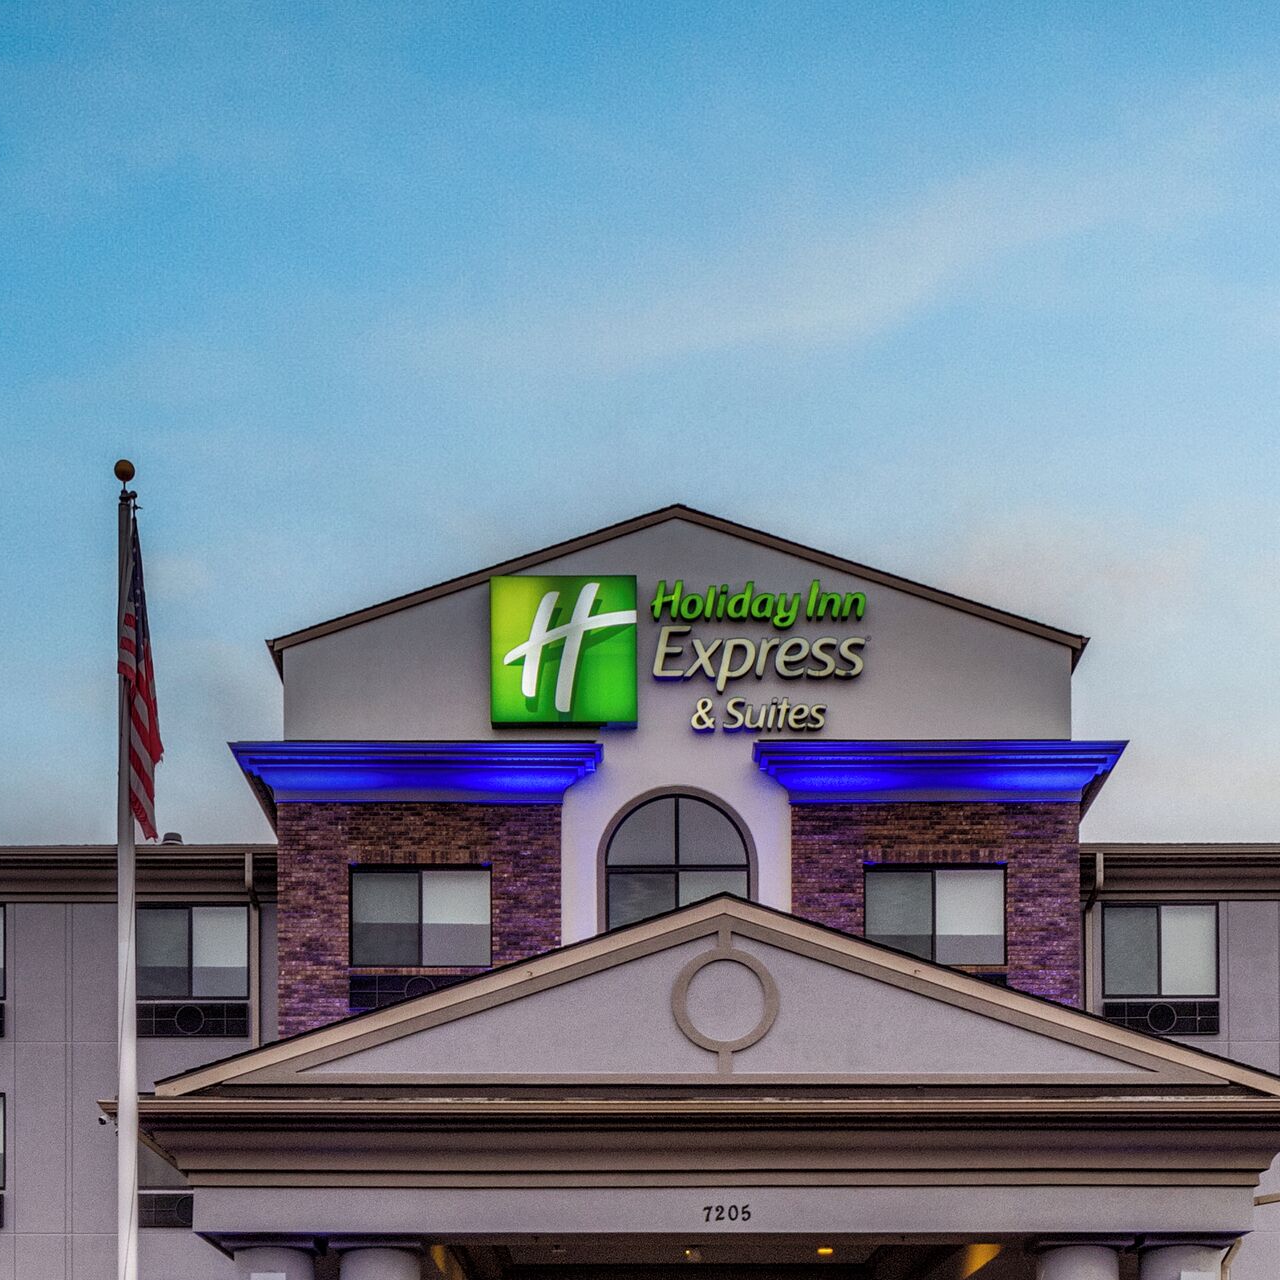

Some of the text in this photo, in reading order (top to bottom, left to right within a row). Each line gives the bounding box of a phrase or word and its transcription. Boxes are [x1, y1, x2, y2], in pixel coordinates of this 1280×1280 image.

[651, 579, 867, 629] Holiday Inn
[503, 582, 637, 713] H
[652, 625, 866, 693] Express
[690, 697, 827, 731] & Suites
[703, 1204, 752, 1222] 7205
